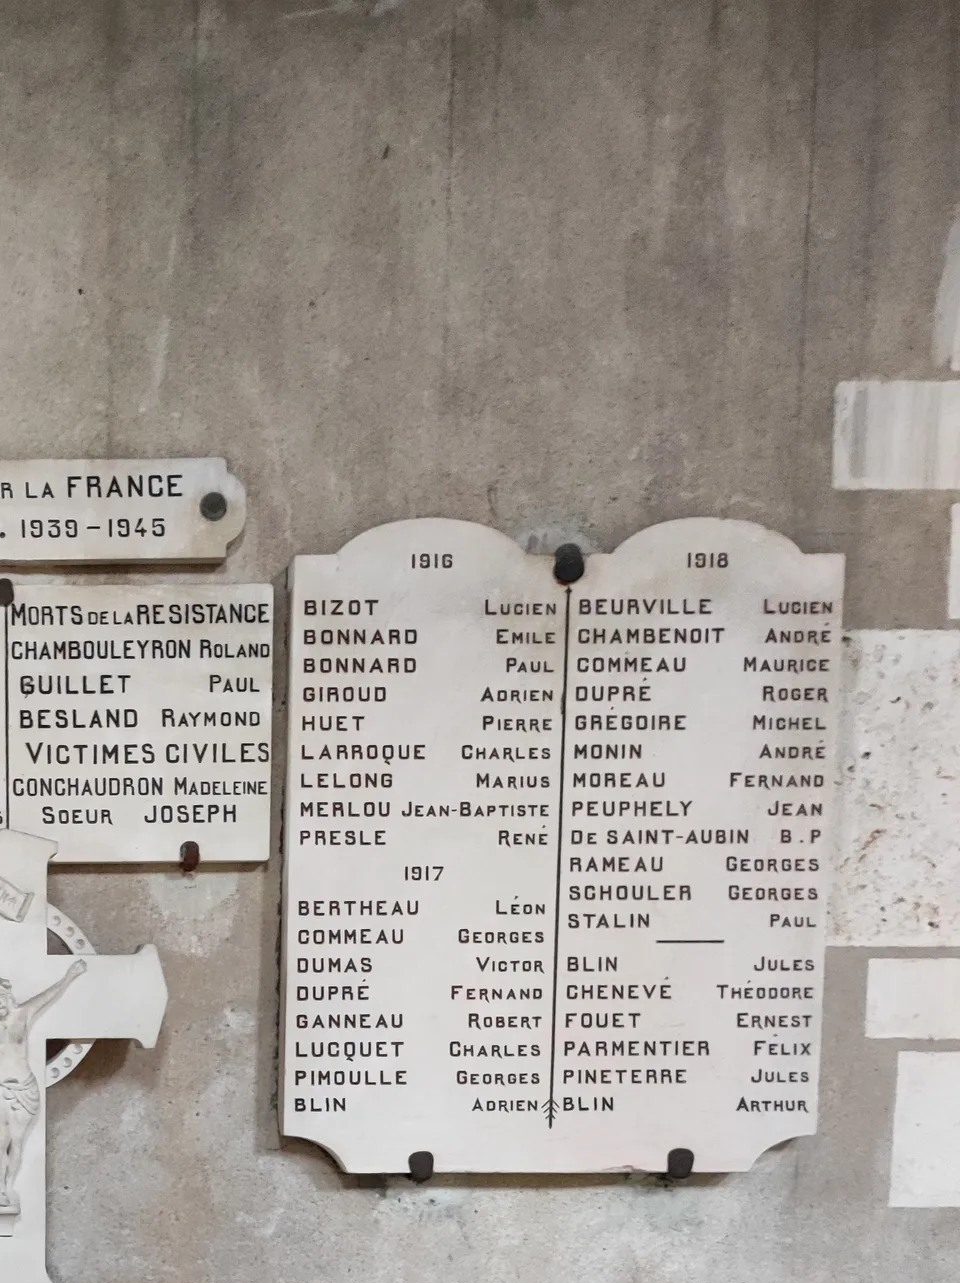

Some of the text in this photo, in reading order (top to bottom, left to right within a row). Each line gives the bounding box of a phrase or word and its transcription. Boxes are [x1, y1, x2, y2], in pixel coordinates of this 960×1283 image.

[24, 481, 55, 499] LA
[66, 474, 184, 499] FRANCE
[411, 552, 453, 570] 1916
[687, 552, 729, 569] 1918
[11, 602, 270, 627] MORTS DE LA RESISTANCE
[303, 598, 557, 617] BIZOT LUCIEN
[578, 598, 833, 616] BEURVILLE LUCIEN
[303, 628, 556, 646] BONNARD EMILE
[10, 638, 270, 661] CHAMBOULEYRON ROLAND
[19, 674, 261, 695] GUILLET PAUL
[575, 677, 829, 703] DUPRÉ ROGER
[302, 686, 554, 705] GIROUD ADRIEN
[19, 708, 261, 730] BESLAND RAYMOND
[301, 715, 553, 734] HUET PIERRE
[574, 706, 827, 732] GRÉGOIRE MICHEL
[24, 741, 269, 765] VICTIMES CIVILES
[573, 739, 826, 761] MONIN ANDRÉ
[12, 776, 268, 797] CONCHAUDRON MADELEINE
[300, 772, 551, 791] LELONG MARIUS
[572, 771, 825, 791] MOREAU FERNAND
[41, 803, 237, 826] SOEUR JOSEPH
[300, 801, 550, 818] MERLOU JEAN-BAPTISTE
[571, 799, 823, 818] PEUPHELY JEAN
[299, 824, 549, 848] PRESLE RENÉ
[570, 829, 598, 846] DE
[606, 828, 750, 845] SAINT-AUBIN
[404, 865, 445, 882] 1917
[569, 855, 820, 874] RAMEAU GEORGES
[568, 884, 819, 902] SCHOULER GEORGES
[297, 895, 546, 917] BERTHEAU LÉON
[567, 912, 817, 930] STALIN PAUL
[297, 928, 545, 945] COMMEAU GEORGES
[296, 956, 545, 975] DUMAS VICTOR
[566, 955, 815, 973] BLIN JULES
[296, 978, 543, 1004] DUPRÉ FERNAND
[566, 976, 814, 1001] CHENEVÉ THÉODORE
[295, 1012, 543, 1031] GANNEAU ROBERT
[564, 1012, 813, 1030] FOUET ERNEST
[295, 1040, 541, 1063] LUCQUET CHARLES
[294, 1069, 541, 1087] PIMOULLE GEORGES
[562, 1068, 810, 1085] PINETERRE JULES
[294, 1097, 538, 1114] BLIN ADRIEN
[562, 1096, 809, 1114] BLIN ARTHUR
